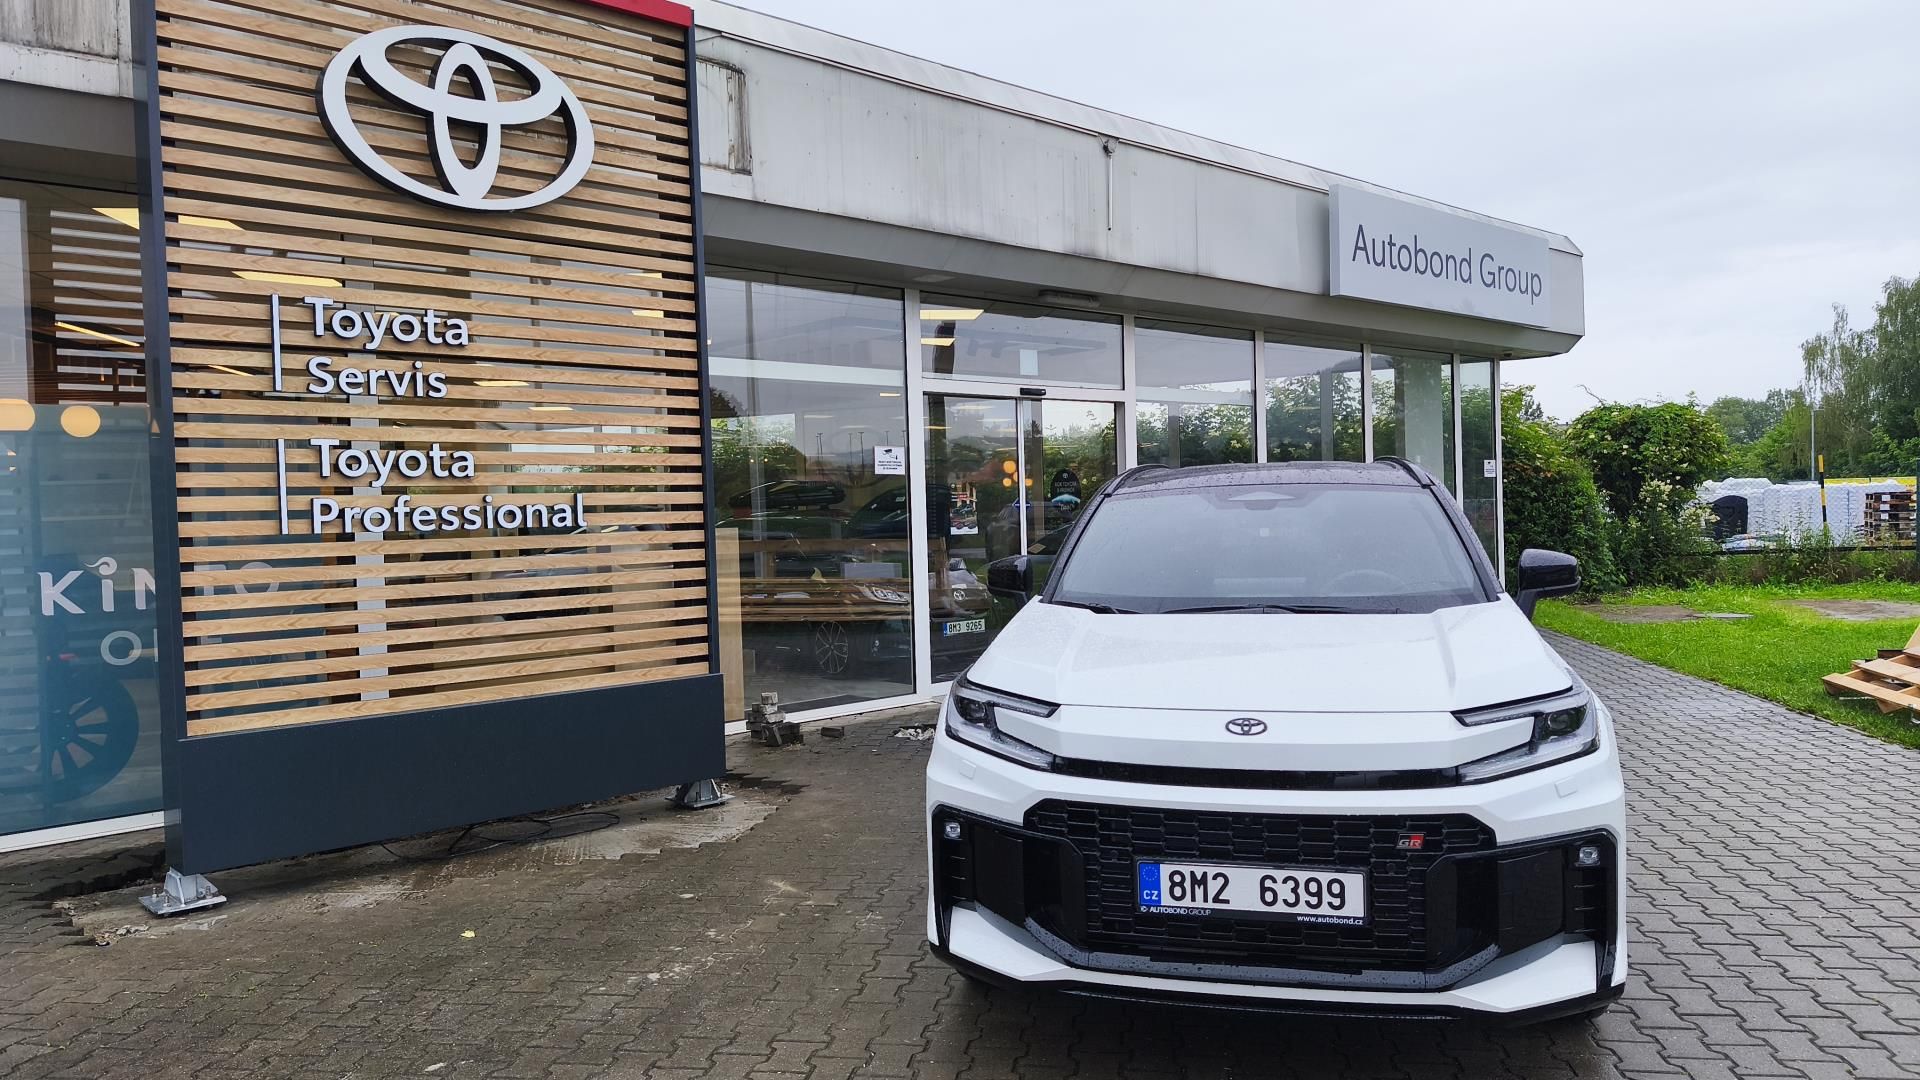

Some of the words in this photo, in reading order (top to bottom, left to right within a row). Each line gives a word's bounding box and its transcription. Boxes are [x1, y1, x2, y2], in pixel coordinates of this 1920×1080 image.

[1352, 224, 1472, 284] Autobond
[1479, 253, 1543, 305] Group
[303, 296, 469, 350] Toyota
[307, 356, 449, 399] Servis
[309, 438, 476, 488] Toyota
[311, 493, 588, 534] Professional
[965, 620, 983, 631] 9265
[1397, 839, 1421, 849] GR
[1143, 890, 1159, 901] CZ
[1168, 869, 1231, 905] 8M2
[1260, 874, 1346, 911] 6399
[1149, 906, 1188, 915] AUTOBOND
[1188, 908, 1212, 916] GROUP
[1296, 915, 1363, 925] www.autobond.cz
